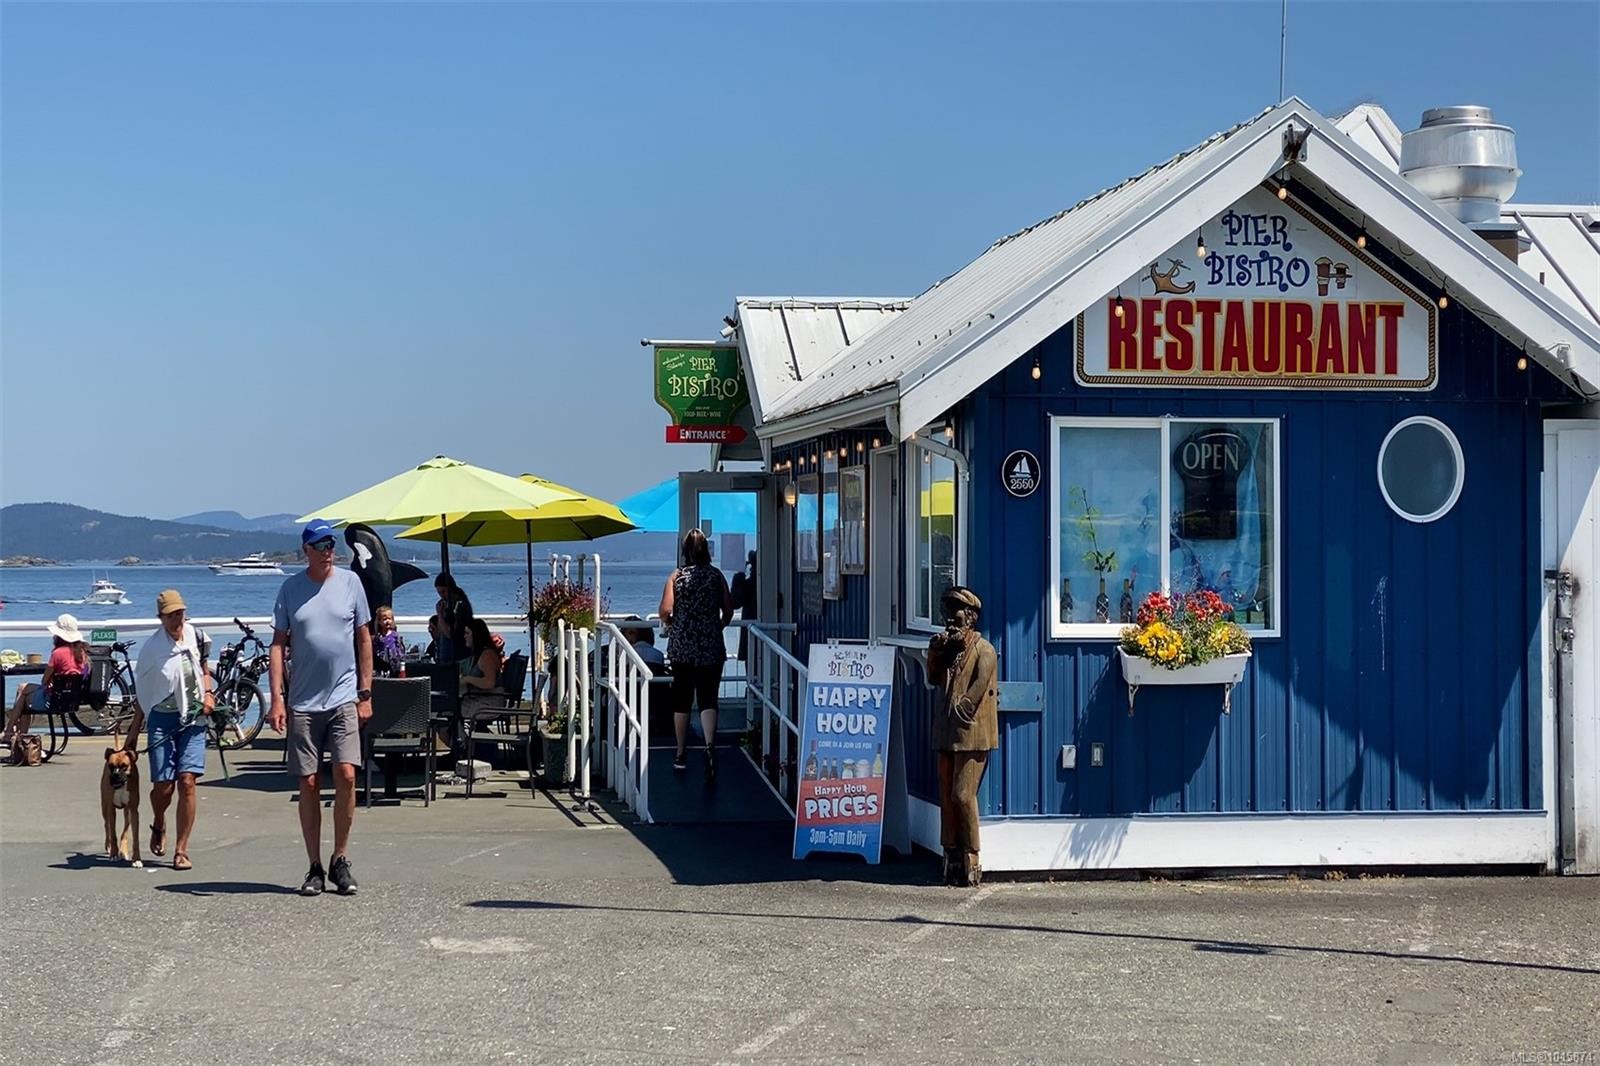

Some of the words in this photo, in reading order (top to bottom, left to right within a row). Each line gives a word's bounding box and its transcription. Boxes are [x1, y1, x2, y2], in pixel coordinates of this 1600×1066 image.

[1221, 210, 1293, 251] PIER
[1204, 250, 1310, 292] BISTRO
[1107, 297, 1405, 374] RESTAURANT
[689, 356, 718, 372] PIER
[668, 373, 738, 400] BISTRO
[680, 429, 727, 440] ENTRANCE
[1182, 441, 1240, 471] OPEN
[1010, 478, 1034, 490] 2550
[93, 631, 115, 639] PLEASE
[828, 660, 874, 680] BISTRO
[813, 686, 887, 709] HAPPY
[816, 713, 878, 735] HOUR
[805, 795, 878, 819] PRICES
[810, 828, 845, 845] 3pm-5pm
[846, 830, 867, 847] Daily
